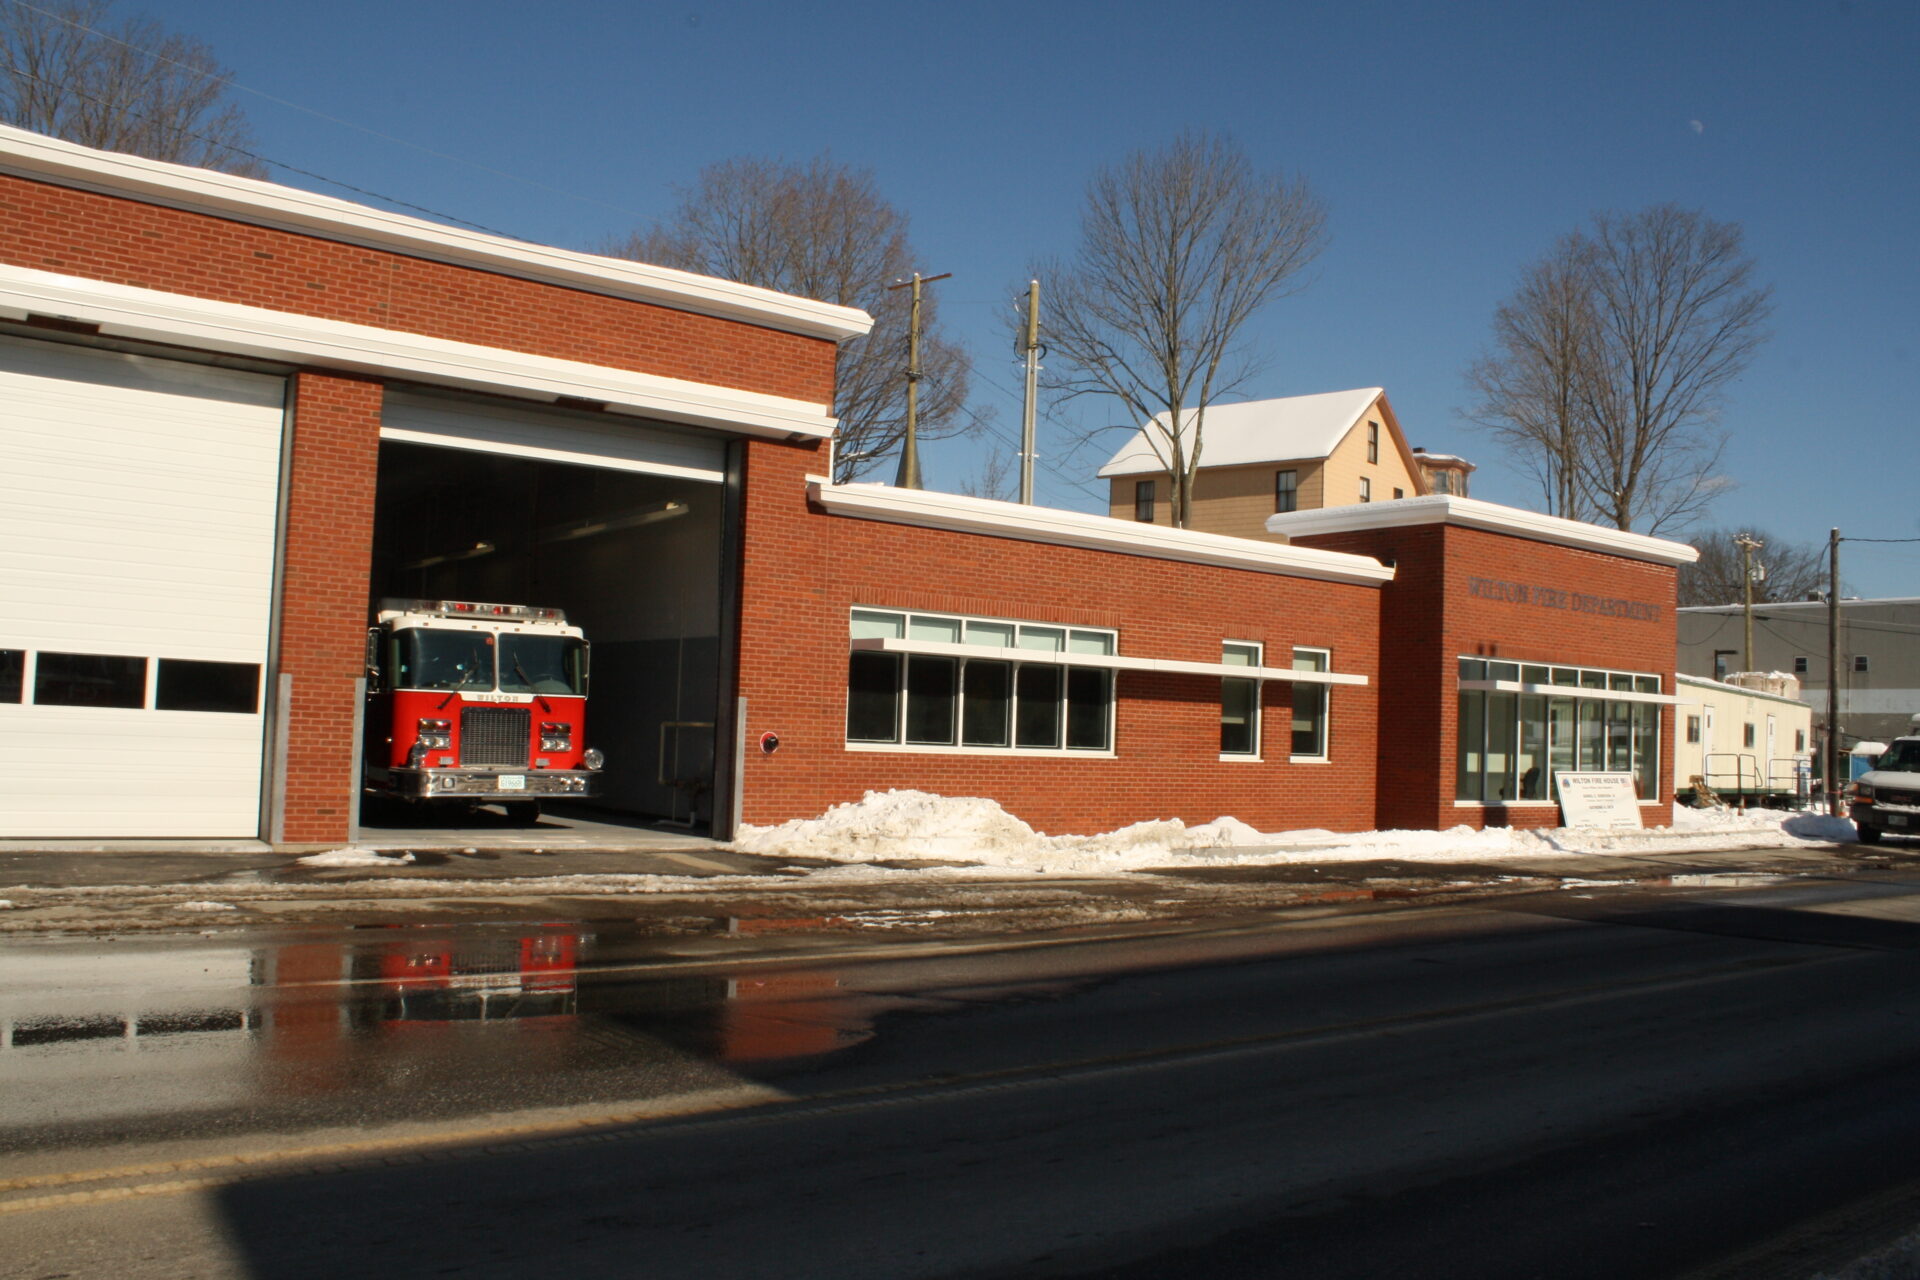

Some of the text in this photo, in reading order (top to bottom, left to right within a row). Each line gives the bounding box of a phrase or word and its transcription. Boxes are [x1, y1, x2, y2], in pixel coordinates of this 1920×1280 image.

[1468, 576, 1662, 623] WILTON FIRE DEPARTMENT
[477, 694, 519, 703] WILTON
[1572, 777, 1592, 785] WILTON
[1592, 777, 1602, 785] FIRE
[1603, 777, 1620, 785] HOUSE
